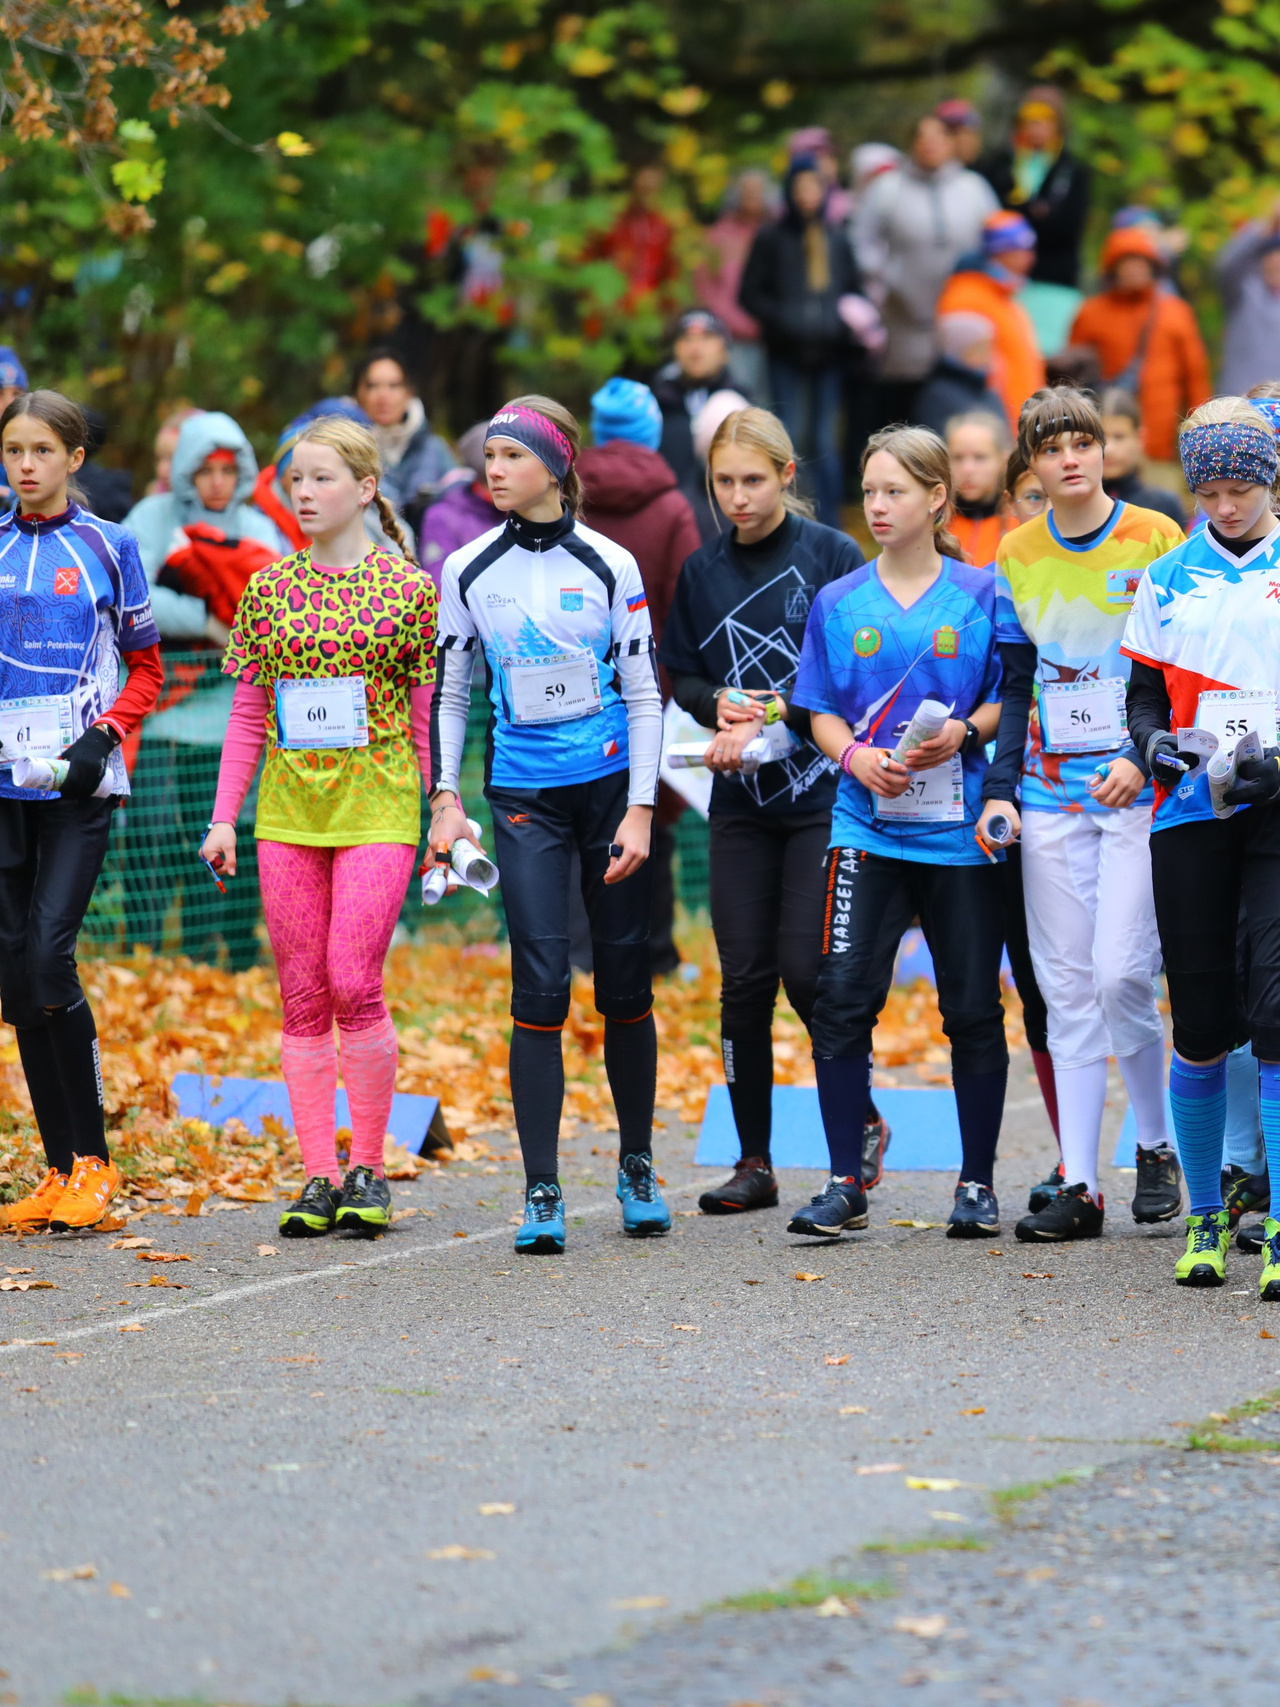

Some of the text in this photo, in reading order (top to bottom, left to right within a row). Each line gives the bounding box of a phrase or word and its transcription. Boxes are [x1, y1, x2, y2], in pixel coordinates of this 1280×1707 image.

[490, 413, 519, 427] RAY
[24, 640, 41, 649] Saint
[47, 641, 85, 650] Petersburg
[545, 683, 566, 702] 59
[308, 706, 327, 722] 60
[1070, 708, 1091, 725] 56
[17, 726, 30, 742] 61
[1225, 719, 1248, 736] 55
[904, 781, 926, 796] 57
[832, 848, 858, 953] НАВСЕГДА
